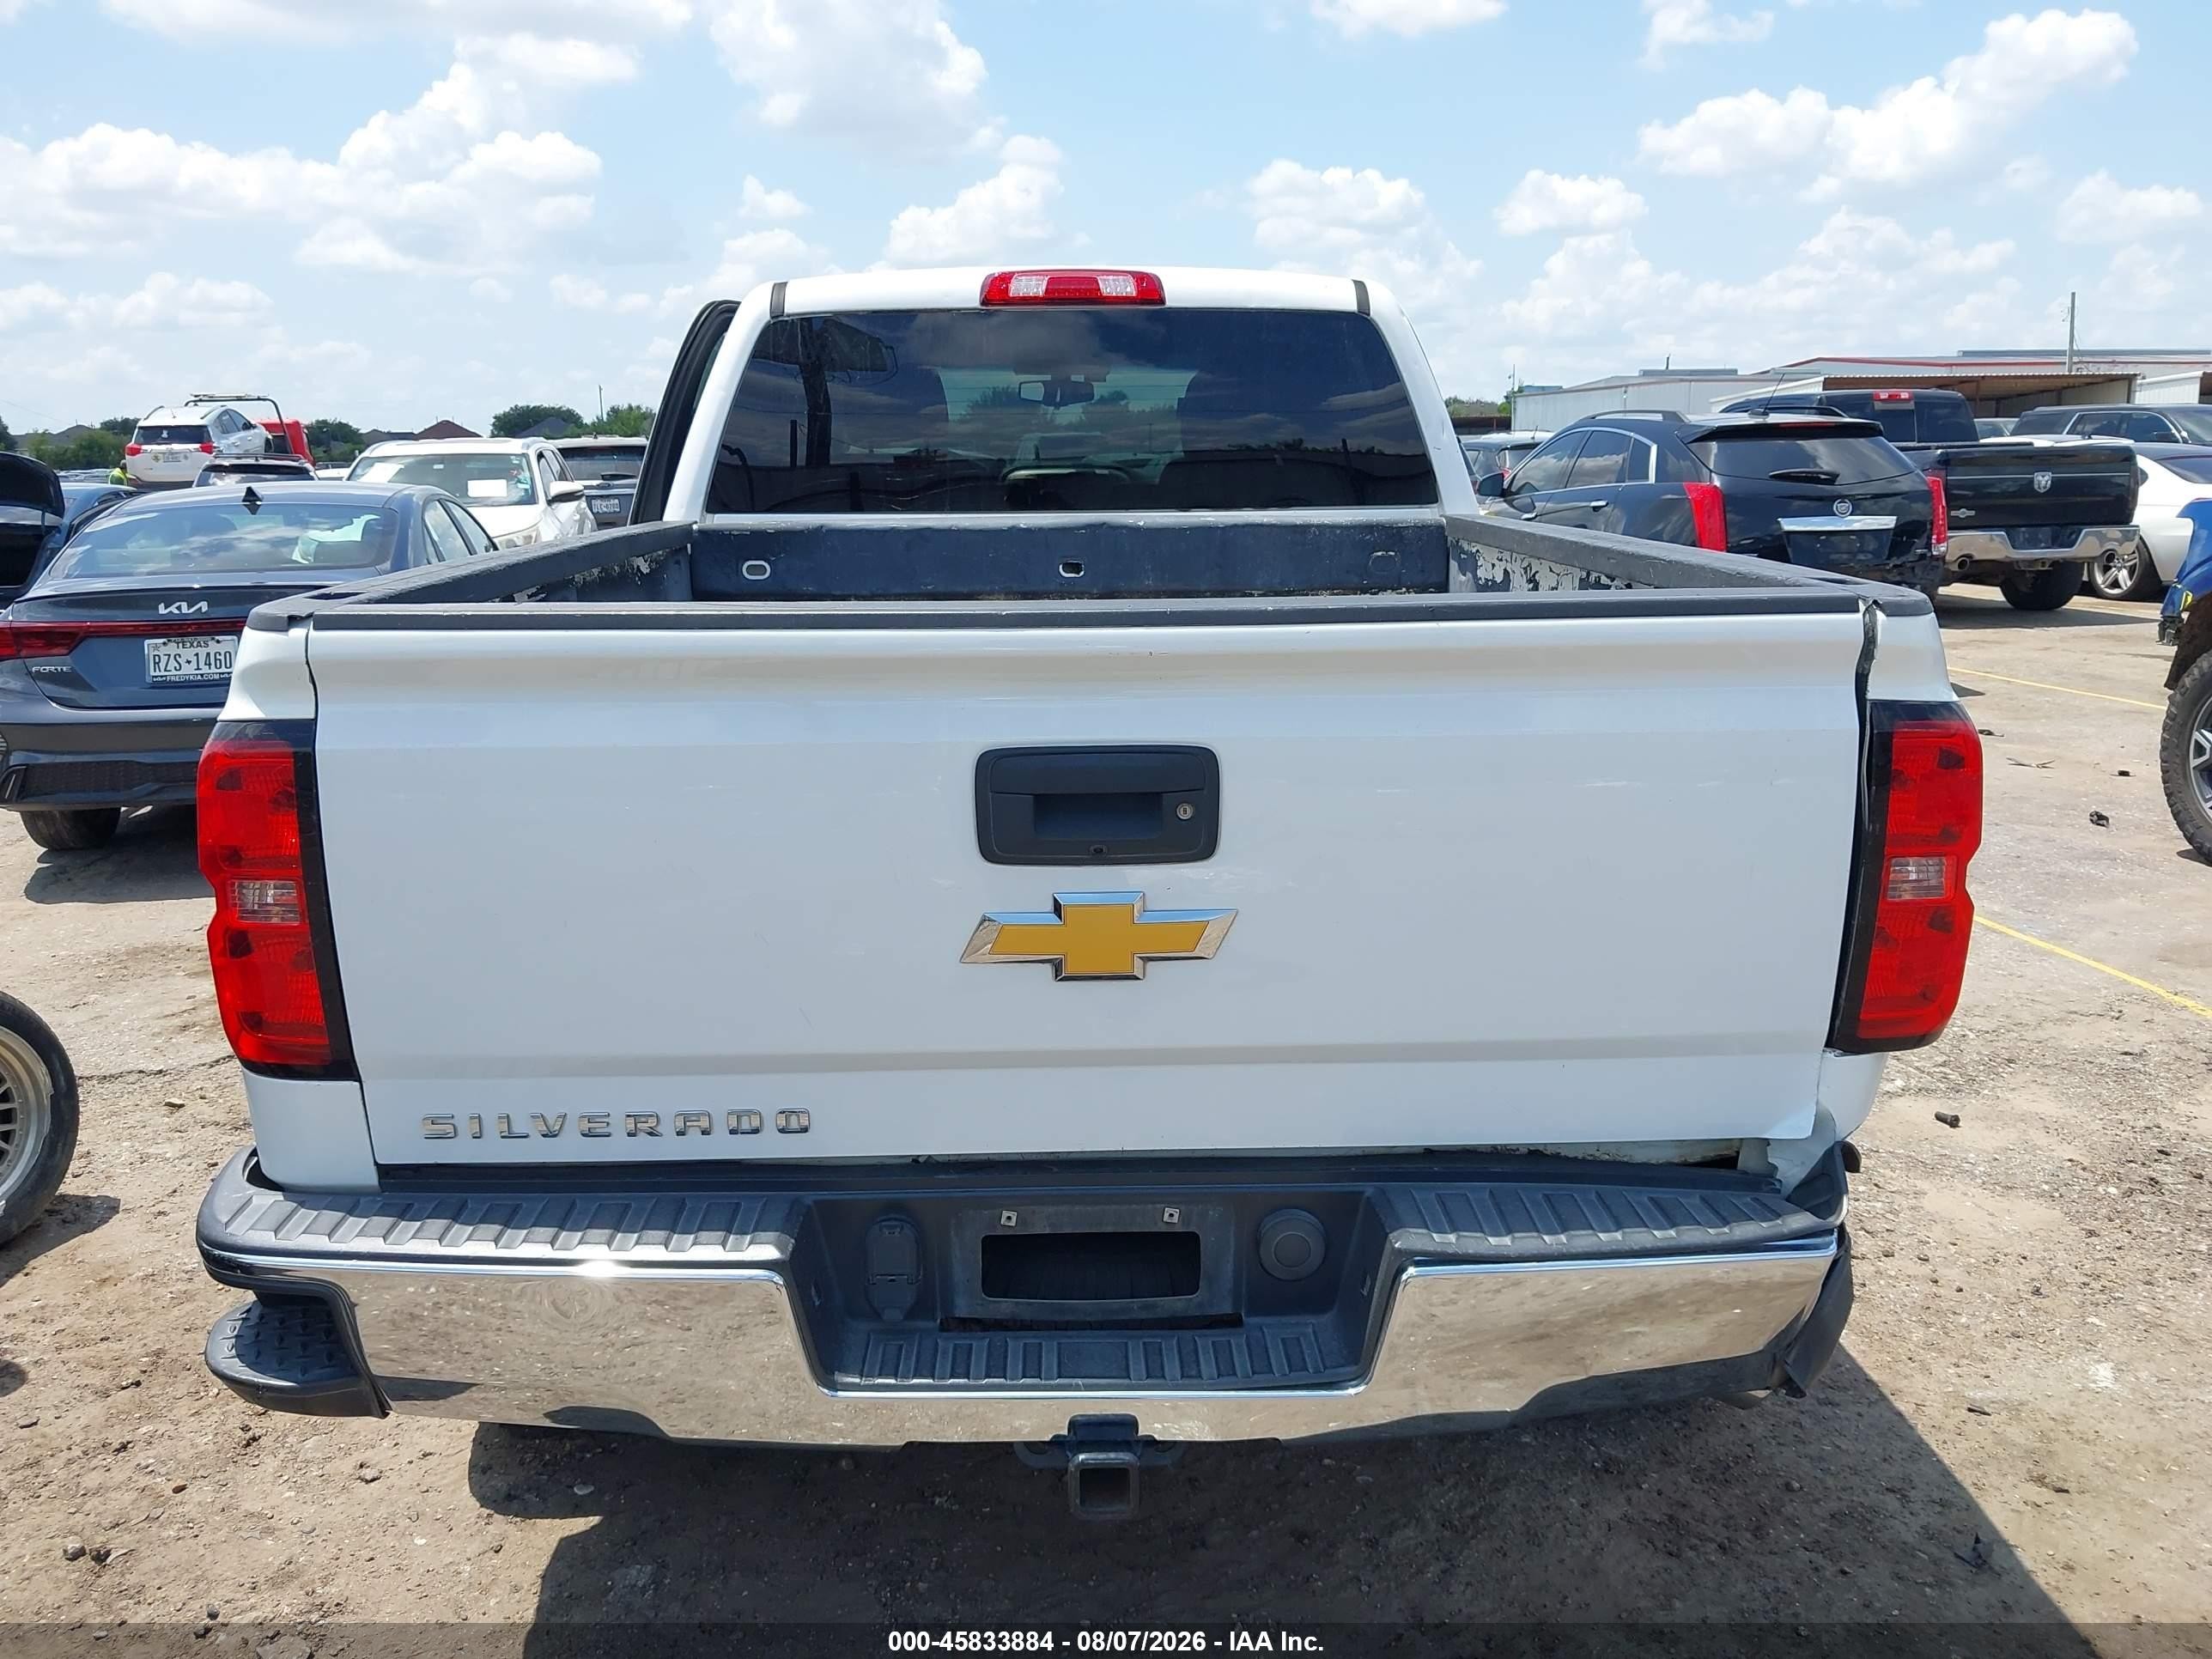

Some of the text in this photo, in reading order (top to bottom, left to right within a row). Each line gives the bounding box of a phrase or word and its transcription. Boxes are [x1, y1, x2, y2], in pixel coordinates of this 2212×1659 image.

[158, 601, 209, 614] KIA
[175, 641, 210, 649] TEXAS
[167, 673, 220, 682] FREDYKIA.COM
[423, 1109, 811, 1139] SILVERADO
